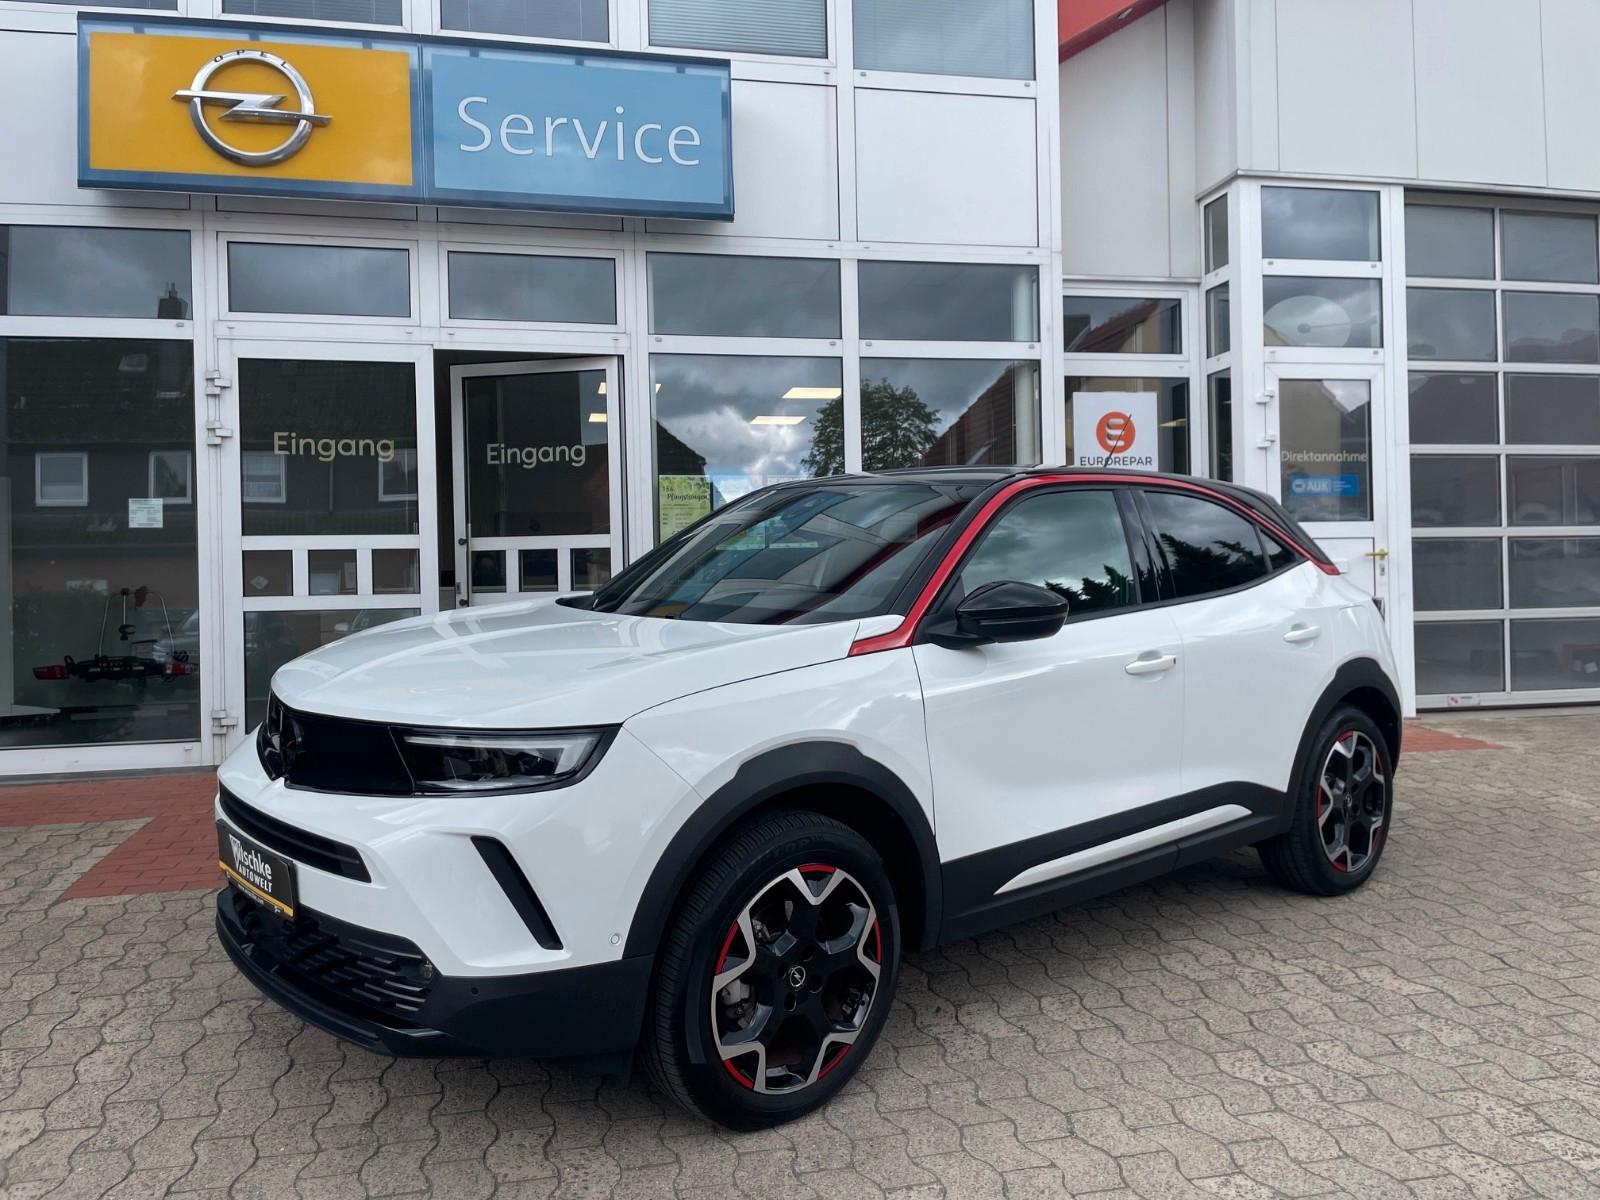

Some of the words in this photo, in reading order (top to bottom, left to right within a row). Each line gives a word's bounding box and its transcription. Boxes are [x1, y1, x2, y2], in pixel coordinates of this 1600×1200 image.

[457, 96, 701, 166] Service
[273, 431, 395, 462] Eingang
[486, 443, 586, 469] Eingang
[1281, 449, 1369, 462] Direktannahme
[1080, 456, 1153, 466] EUROREPAR
[238, 863, 273, 893] AUTOWELT
